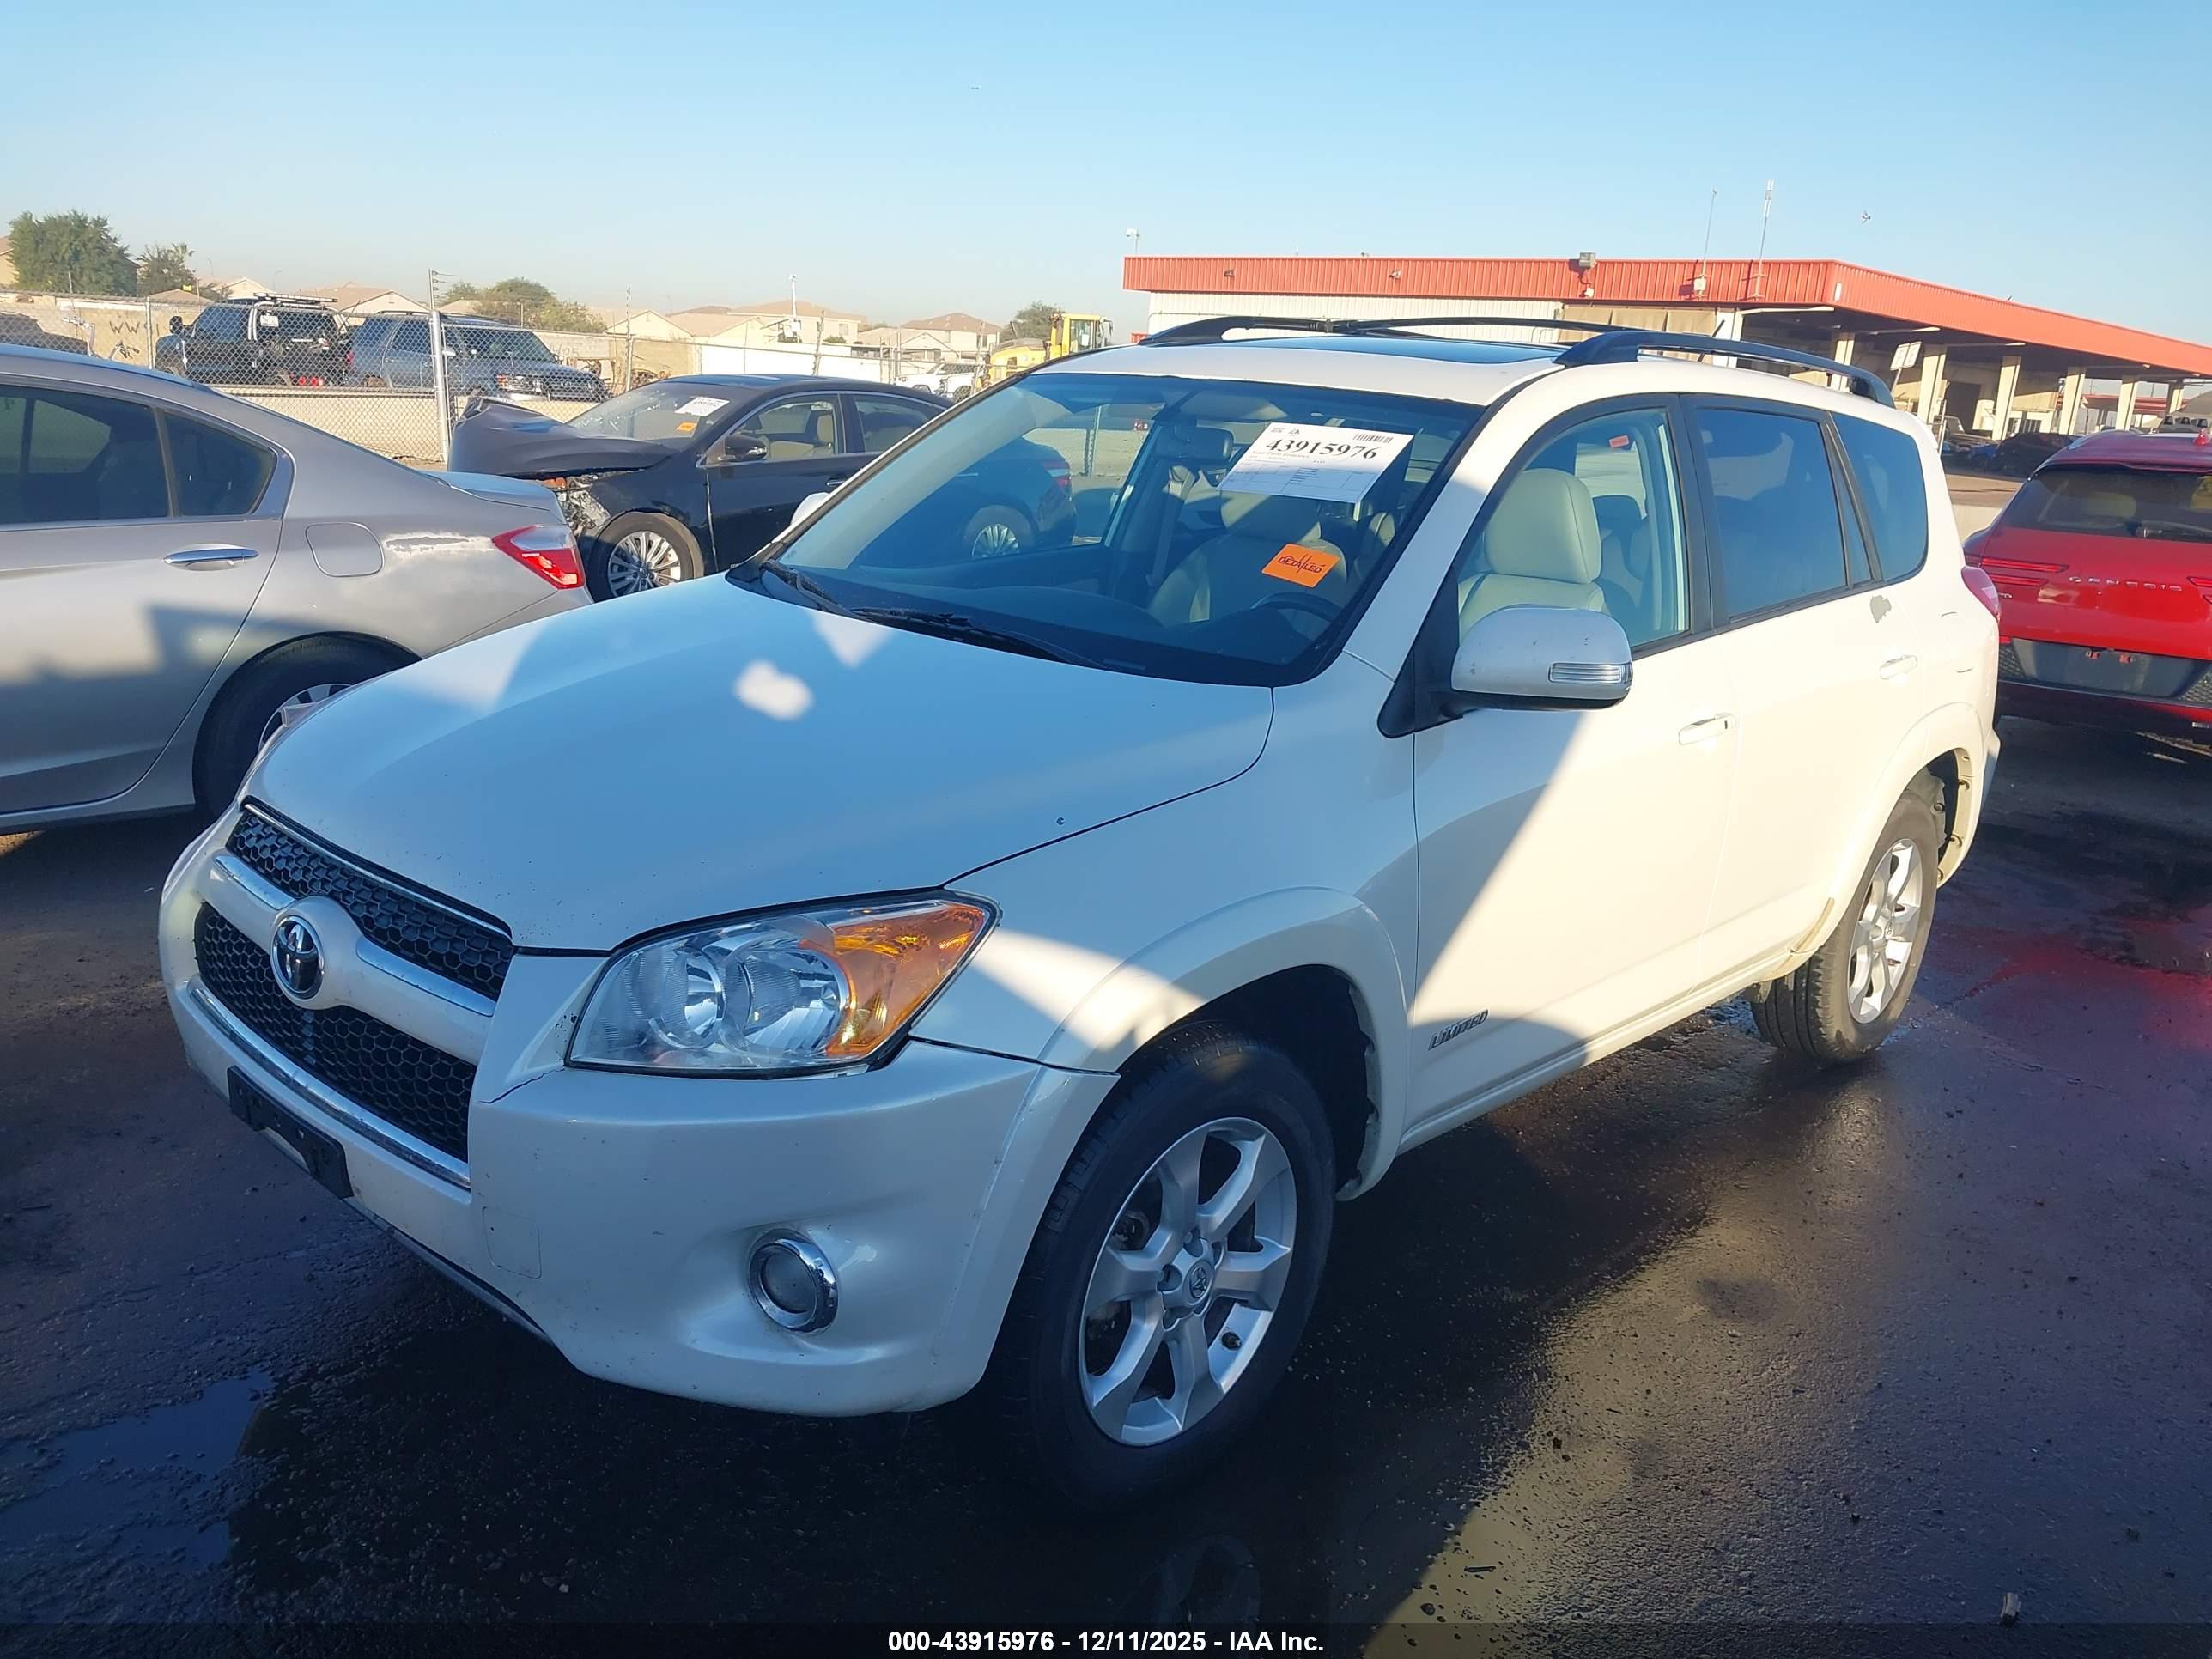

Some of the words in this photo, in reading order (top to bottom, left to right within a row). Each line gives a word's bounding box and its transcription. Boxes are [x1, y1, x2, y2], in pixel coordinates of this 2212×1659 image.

[1265, 439, 1381, 459] 43915976
[1278, 554, 1323, 574] DETAILED
[1428, 1009, 1488, 1051] LIMITED
